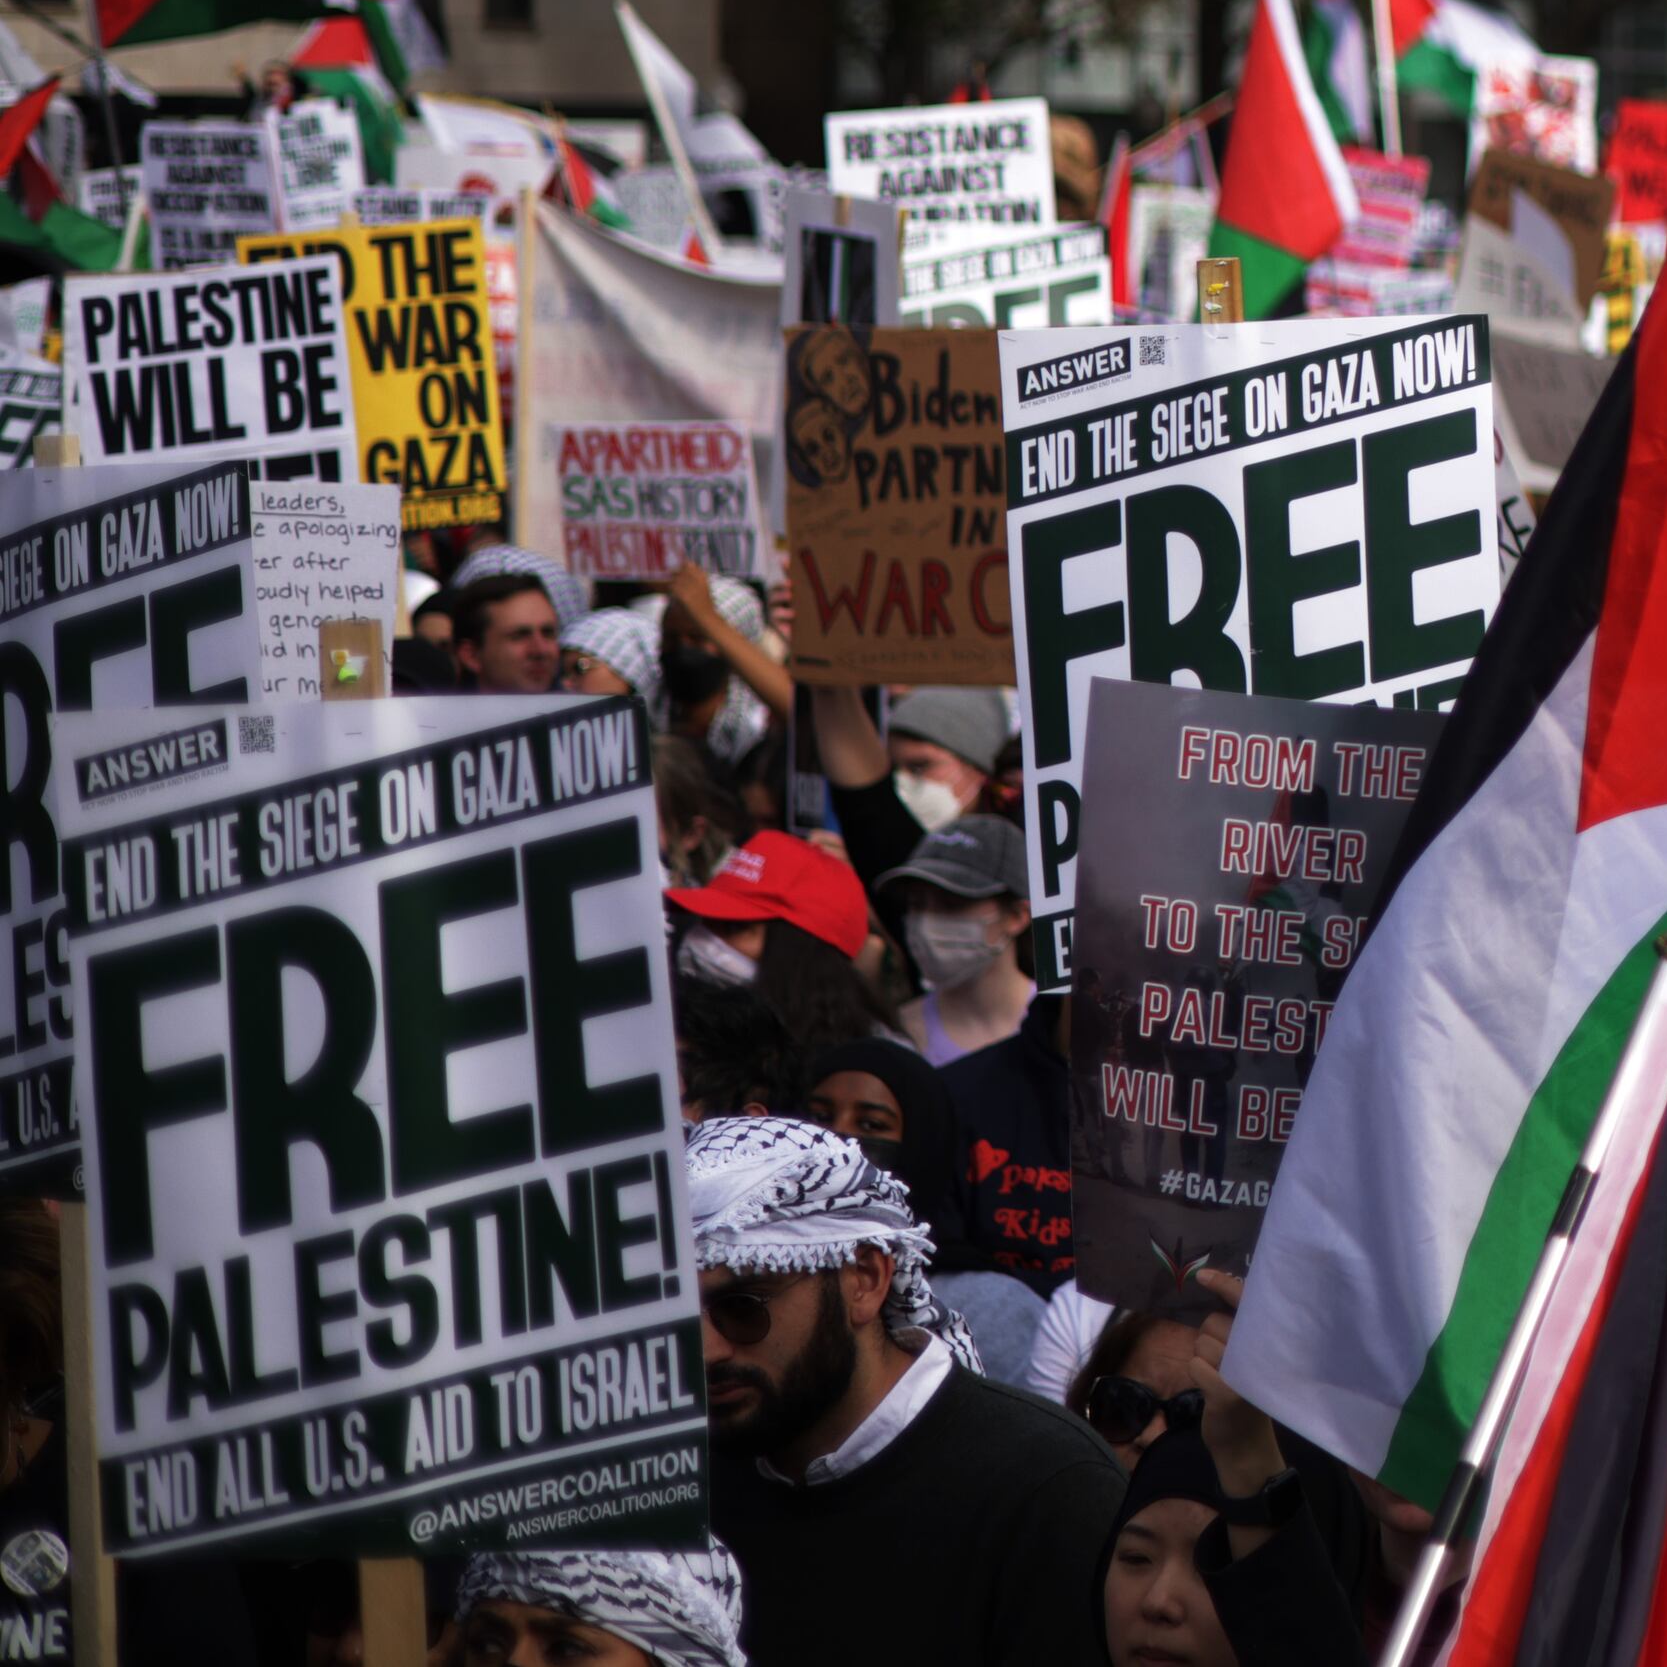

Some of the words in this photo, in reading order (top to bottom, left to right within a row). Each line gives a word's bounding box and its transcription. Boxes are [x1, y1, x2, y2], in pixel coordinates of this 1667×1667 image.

[843, 119, 1028, 161] RESISTANCE
[878, 164, 1004, 198] AGAINST
[369, 231, 476, 299] THE
[81, 268, 337, 364] PALESTINE
[354, 301, 483, 373] WAR
[90, 355, 247, 455] WILL
[262, 343, 343, 435] BE
[419, 370, 489, 429] ON
[869, 350, 997, 436] Biden
[1025, 346, 1125, 395] ANSWER
[1021, 431, 1076, 498] END
[1089, 412, 1139, 479] THE
[1151, 387, 1230, 463] SIEGE
[1245, 373, 1288, 438] ON
[1301, 350, 1380, 423] GAZA
[1393, 324, 1477, 399] NOW!
[366, 432, 496, 495] GAZA
[54, 521, 89, 594] ON
[101, 499, 164, 578] GAZA
[175, 473, 239, 554] NOW!
[261, 493, 345, 514] leaders,
[279, 521, 397, 548] apologizing
[952, 504, 998, 547] IN
[293, 552, 350, 571] after
[319, 583, 384, 603] helped
[801, 547, 956, 638] WAR
[1021, 407, 1487, 769] FREE
[87, 730, 219, 793] ANSWER
[1178, 726, 1317, 793] FROM
[1333, 742, 1426, 801] THE
[85, 836, 156, 924] END
[171, 812, 242, 899] THE
[258, 781, 361, 877] SIEGE
[379, 760, 436, 845] ON
[452, 736, 540, 826] GAZA
[550, 708, 638, 801] NOW!
[1220, 818, 1367, 883] RIVER
[1140, 895, 1198, 953] TO
[1215, 904, 1305, 965] THE
[87, 816, 665, 1269] FREE
[17, 1072, 58, 1147] U.S.
[1102, 1063, 1217, 1136] WILL
[1237, 1086, 1304, 1142] BE
[108, 1150, 680, 1433] PALESTINE!
[125, 1452, 198, 1538] END
[214, 1431, 289, 1518] ALL
[304, 1410, 385, 1495] U.S.
[405, 1385, 472, 1475] AID
[491, 1366, 541, 1448] TO
[561, 1334, 694, 1433] ISRAEL
[410, 1447, 700, 1543] @ANSWERCOALITION
[506, 1484, 700, 1541] ANSWERCOALITION.ORG
